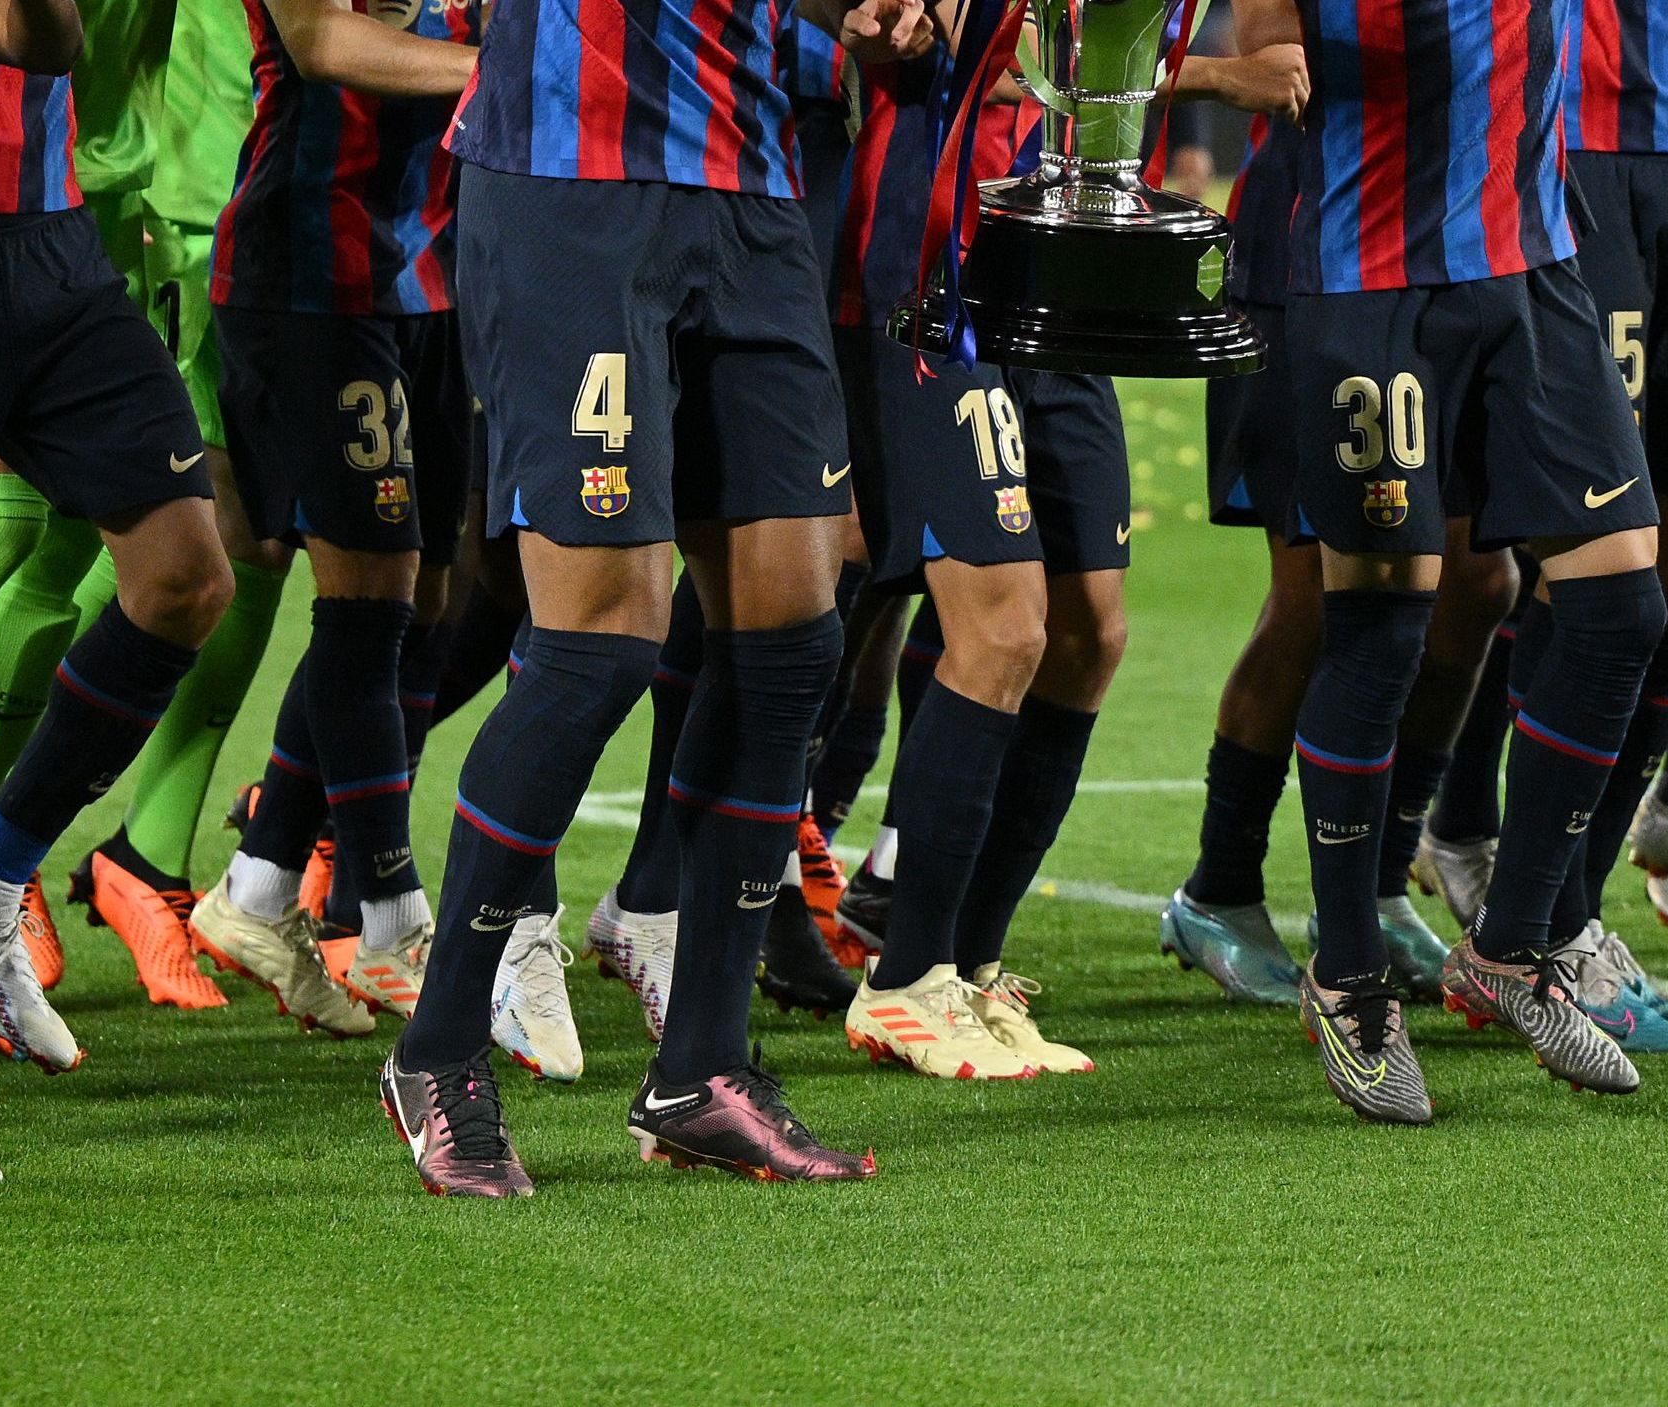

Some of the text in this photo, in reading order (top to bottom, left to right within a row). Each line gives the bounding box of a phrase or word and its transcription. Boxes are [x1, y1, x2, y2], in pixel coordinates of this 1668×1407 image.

[1609, 310, 1645, 400] 5
[338, 377, 413, 471] 32
[571, 353, 633, 453] 4
[954, 387, 1026, 480] 18
[1333, 372, 1425, 472] 30
[595, 487, 616, 495] FCB
[1316, 818, 1371, 835] CULERS
